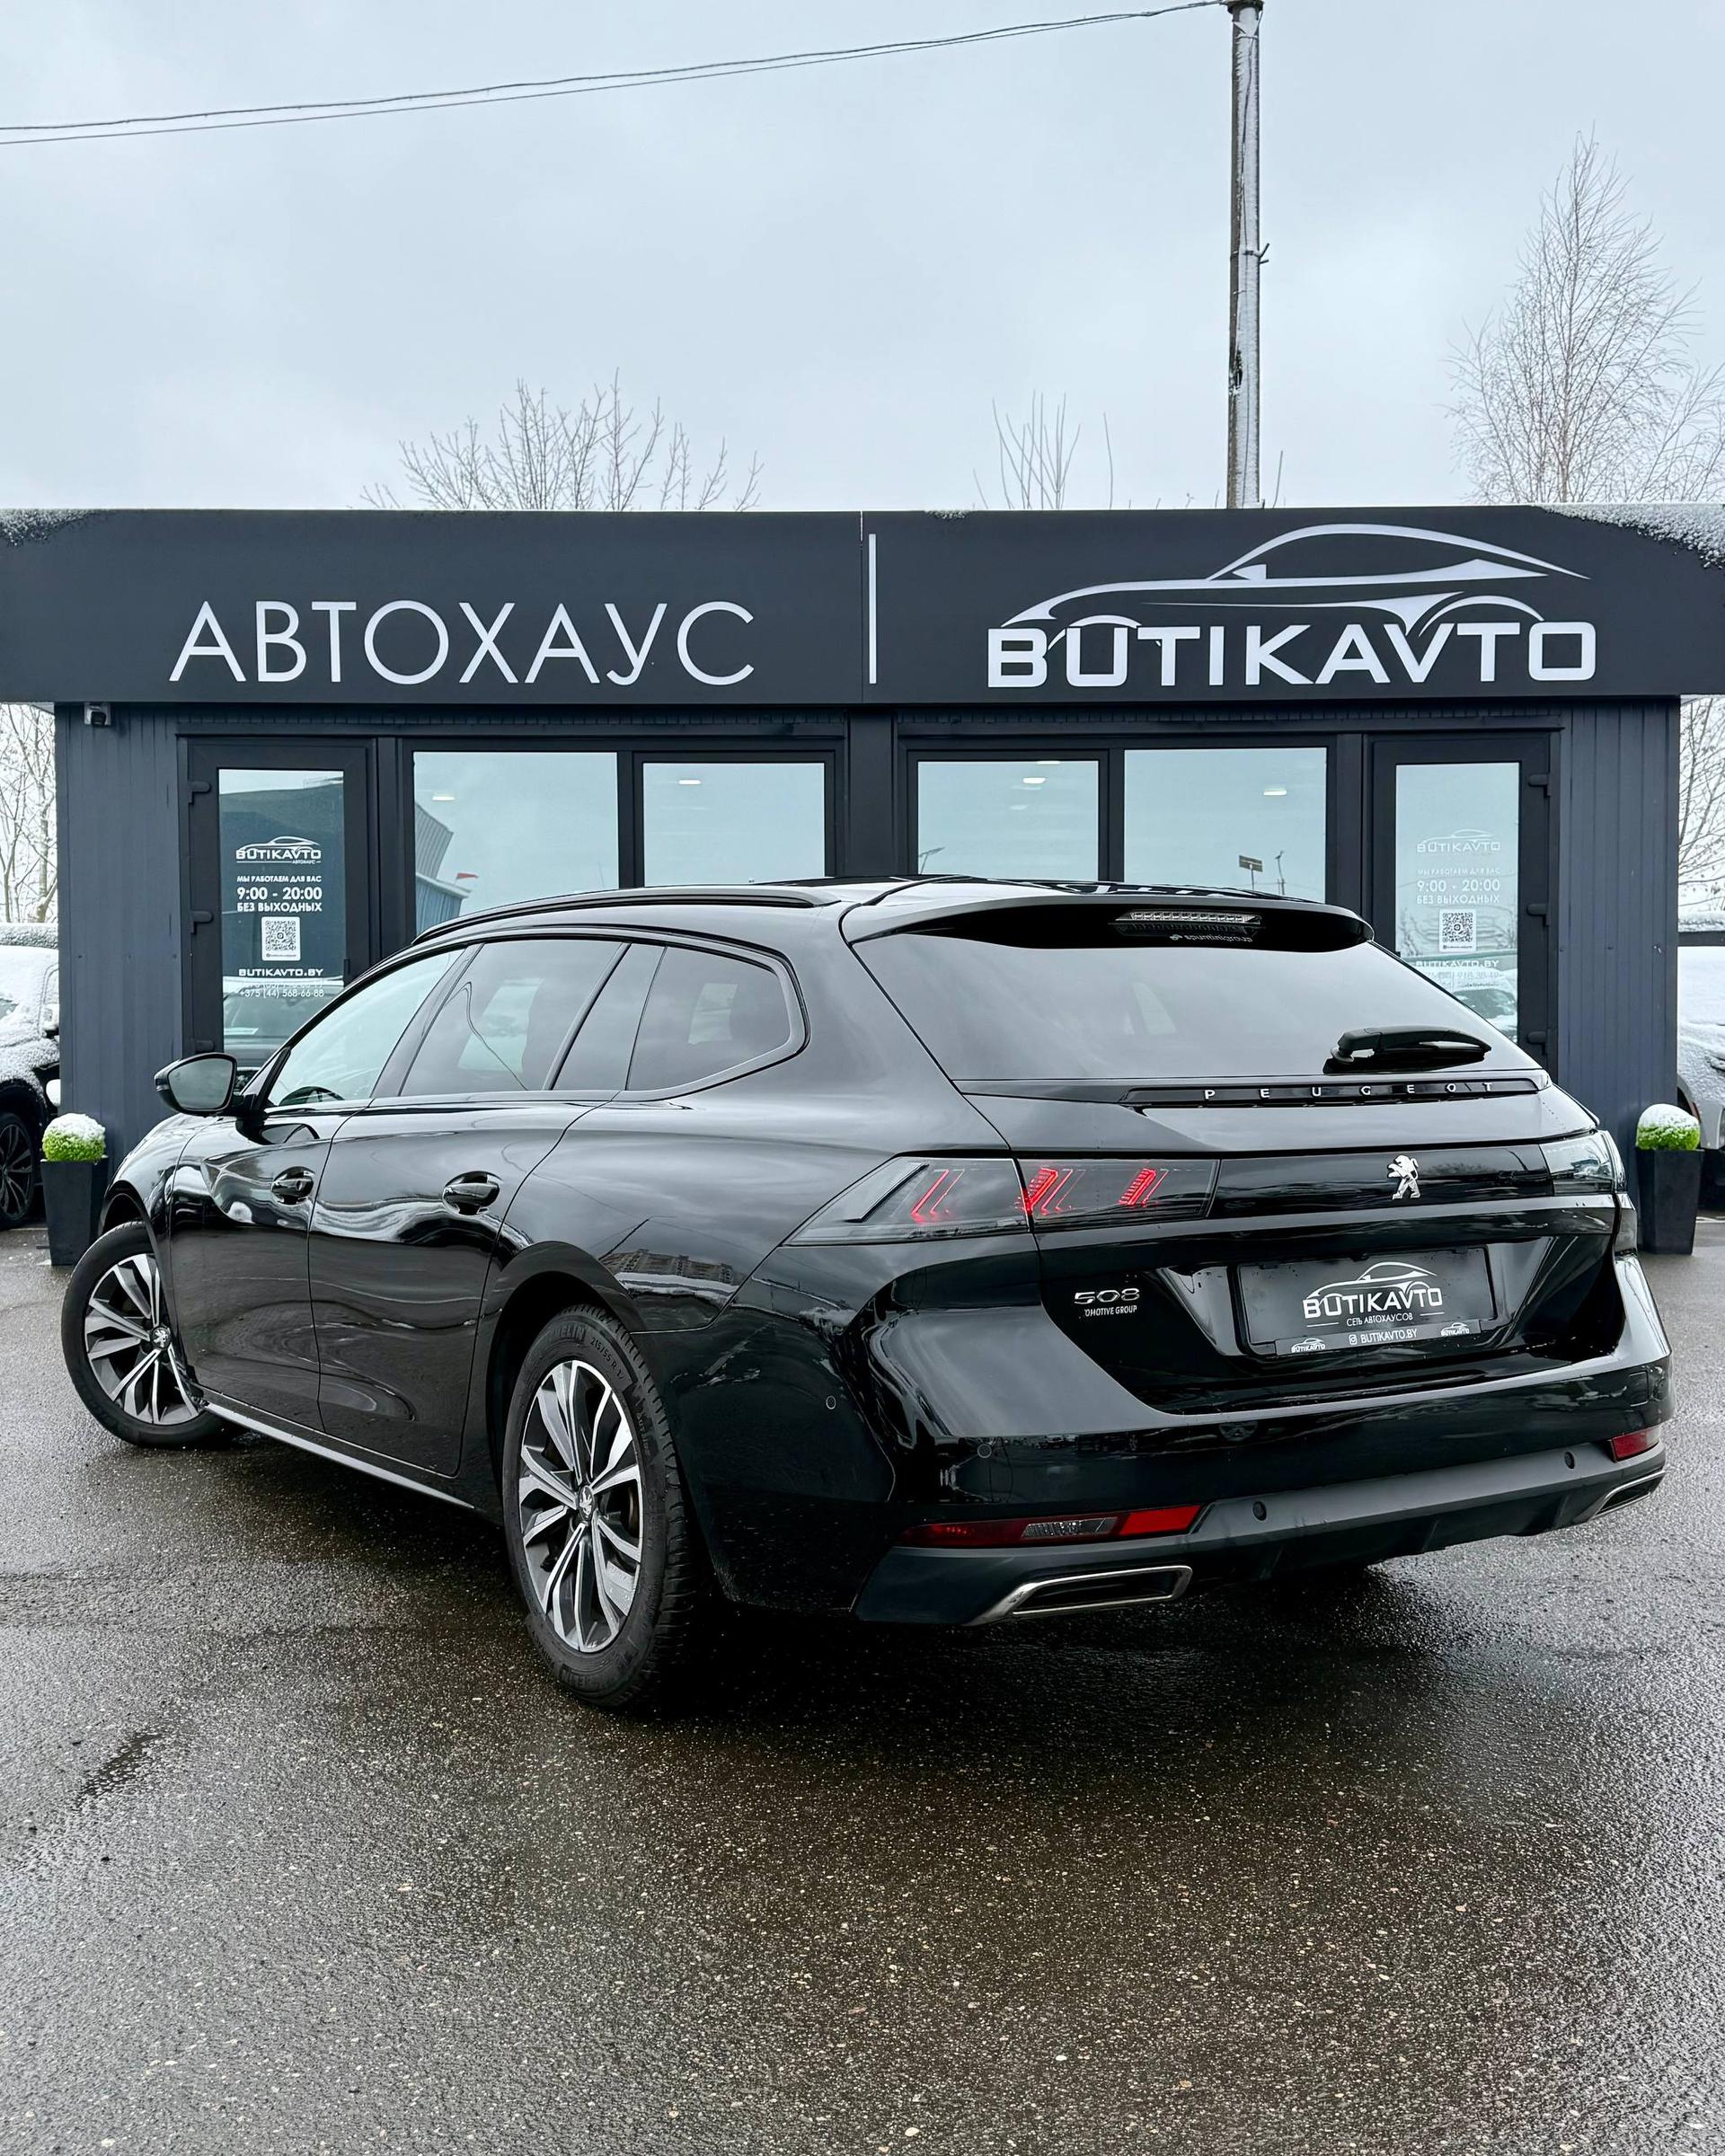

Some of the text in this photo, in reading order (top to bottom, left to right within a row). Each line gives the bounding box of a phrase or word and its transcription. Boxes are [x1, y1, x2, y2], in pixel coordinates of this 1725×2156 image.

[169, 599, 755, 685] АВТОХАУС
[987, 621, 1597, 689] BUTIKAVTO
[1416, 841, 1500, 853] BUTIKAVTO
[235, 849, 322, 860] BUTIKAVTO
[290, 875, 305, 883] ДЛЯ
[1417, 879, 1446, 892] 9:00
[1462, 879, 1500, 892] 20:00
[236, 887, 268, 900] 9:00
[282, 887, 323, 900] 20:00
[1417, 894, 1500, 905] БЕЗ ВЫХОДНЫХ
[236, 902, 323, 913] БЕЗ ВЫХОДНЫХ
[238, 968, 323, 976] BUTIKAVTO.BY
[239, 988, 261, 997] +375
[263, 988, 279, 999] (44)
[1204, 1082, 1496, 1100] PEUGEOT
[1074, 1287, 1140, 1304] 508
[1115, 1304, 1137, 1315] GROUP
[1303, 1287, 1443, 1319] BUTIKAVTO
[1346, 1312, 1413, 1327] СЕТЬ АВТОХАУСОВ
[1359, 1328, 1418, 1344] BUTIKAVTO.BY
